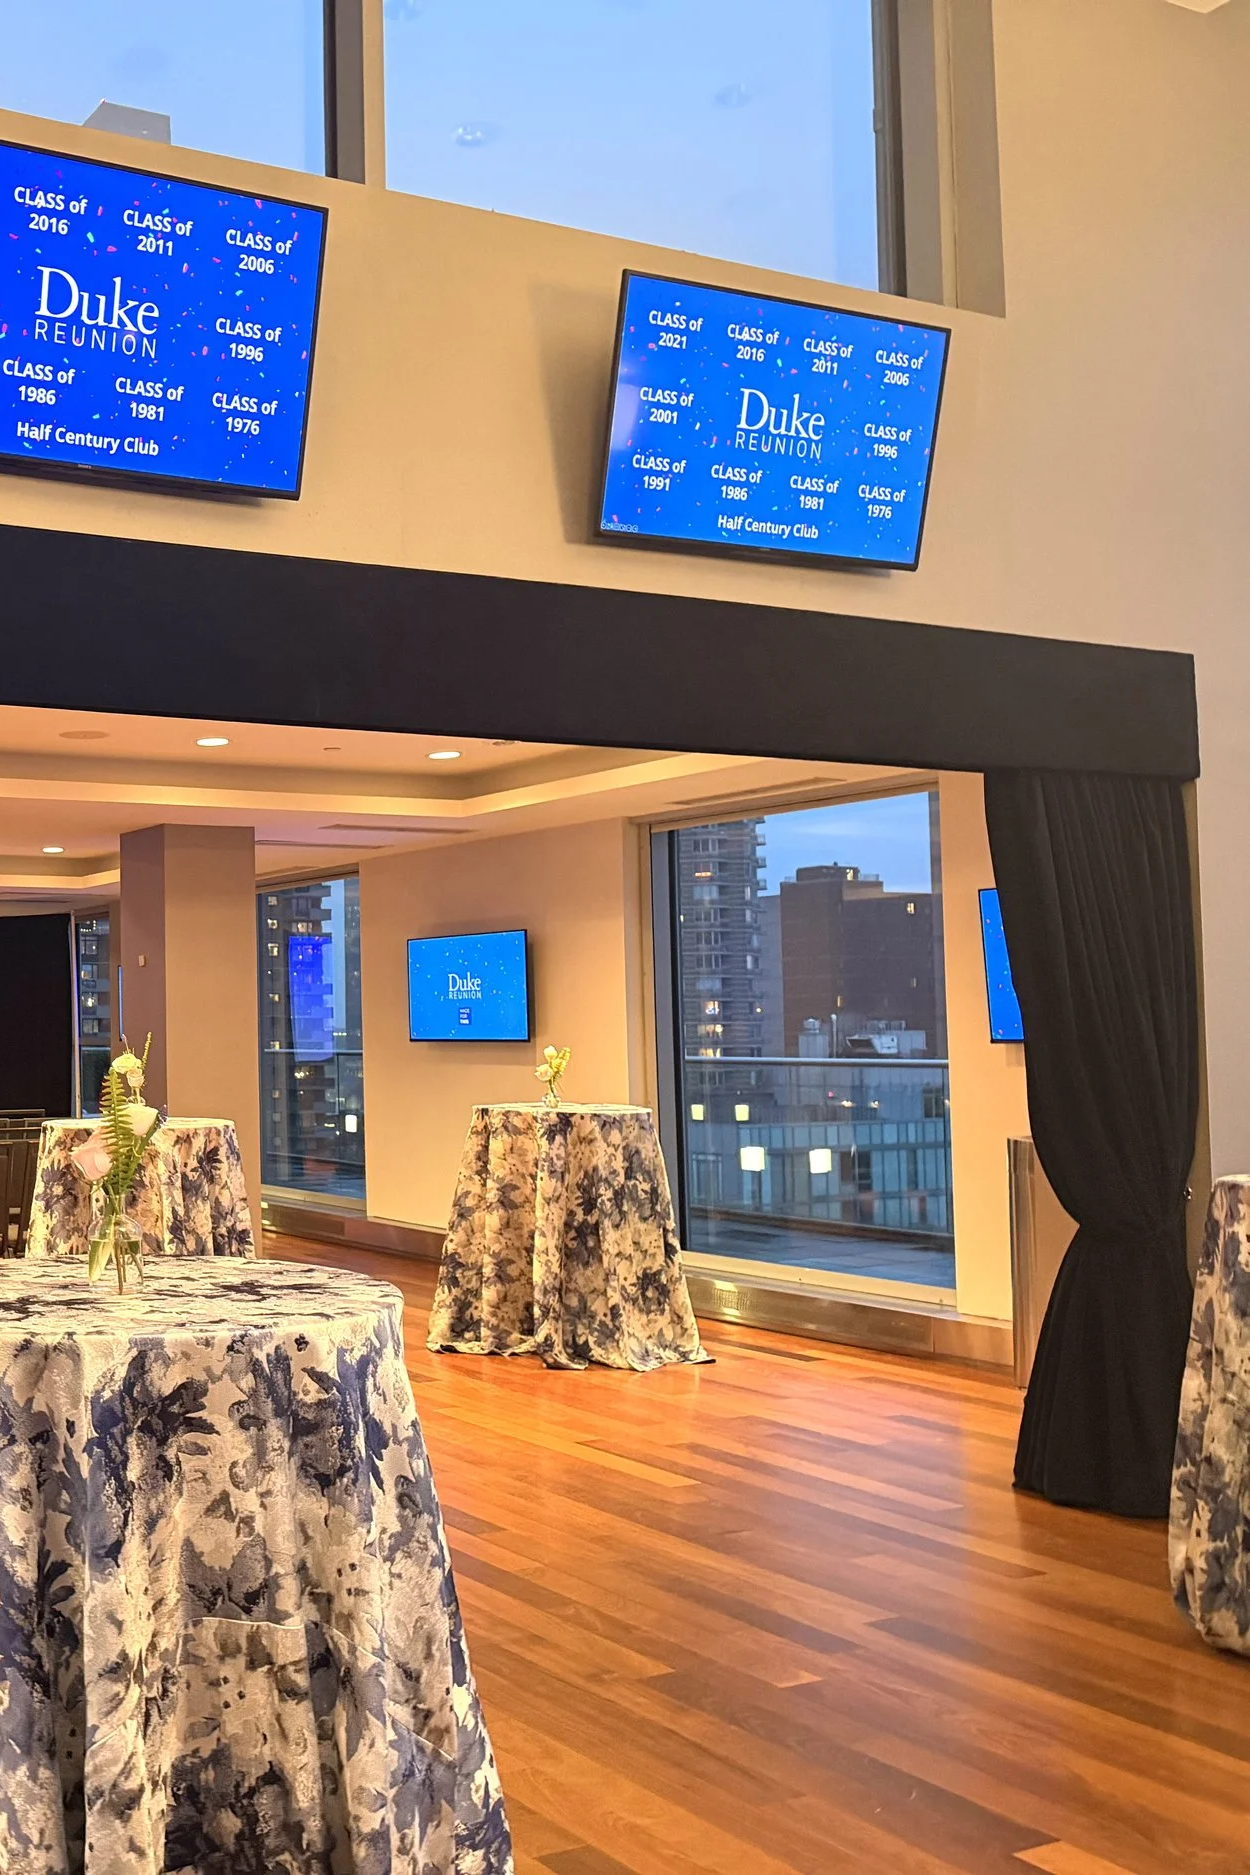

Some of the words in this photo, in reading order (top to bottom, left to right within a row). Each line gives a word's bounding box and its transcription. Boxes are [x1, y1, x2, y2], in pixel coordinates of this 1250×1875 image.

[14, 186, 65, 211] CLASS
[69, 198, 89, 215] of
[28, 213, 68, 235] 2016
[123, 209, 172, 233] CLASS
[175, 220, 194, 237] of
[136, 234, 173, 256] 2011
[225, 229, 273, 252] CLASS
[275, 239, 293, 256] of
[238, 254, 275, 275] 2006
[34, 265, 160, 337] Duke
[215, 317, 262, 339] CLASS
[264, 327, 282, 343] of
[648, 310, 687, 330] CLASS
[688, 317, 704, 332] of
[34, 318, 157, 359] REUNION
[658, 332, 687, 349] 2021
[727, 323, 764, 343] CLASS
[765, 331, 780, 345] of
[229, 342, 264, 362] 1996
[736, 345, 765, 362] 2016
[803, 338, 839, 356] CLASS
[839, 344, 854, 358] of
[811, 358, 838, 375] 2011
[875, 349, 910, 368] CLASS
[910, 356, 924, 369] of
[2, 359, 54, 382] CLASS
[57, 368, 76, 385] of
[883, 370, 910, 386] 2006
[18, 385, 56, 405] 1986
[115, 377, 164, 399] CLASS
[166, 385, 185, 402] of
[639, 386, 678, 405] CLASS
[679, 392, 695, 407] of
[129, 401, 164, 422] 1981
[212, 392, 258, 413] CLASS
[261, 400, 279, 416] of
[649, 408, 678, 425] 2001
[736, 388, 825, 441] Duke
[225, 416, 260, 435] 1976
[864, 423, 898, 440] CLASS
[898, 429, 912, 442] of
[16, 421, 53, 442] Half
[55, 427, 121, 455] Century
[123, 437, 159, 456] Club
[735, 430, 823, 460] REUNION
[873, 443, 898, 459] 1996
[632, 454, 671, 472] CLASS
[672, 459, 687, 474] of
[711, 464, 747, 482] CLASS
[748, 470, 763, 483] of
[643, 475, 671, 491] 1991
[721, 485, 748, 501] 1986
[789, 475, 825, 492] CLASS
[825, 480, 840, 494] of
[799, 494, 824, 511] 1981
[858, 484, 892, 501] CLASS
[892, 489, 907, 503] of
[867, 504, 892, 519] 1976
[717, 514, 744, 531] Half
[744, 518, 792, 539] Century
[793, 523, 819, 539] Club
[447, 971, 482, 991] Duke
[448, 990, 482, 1000] REUNION
